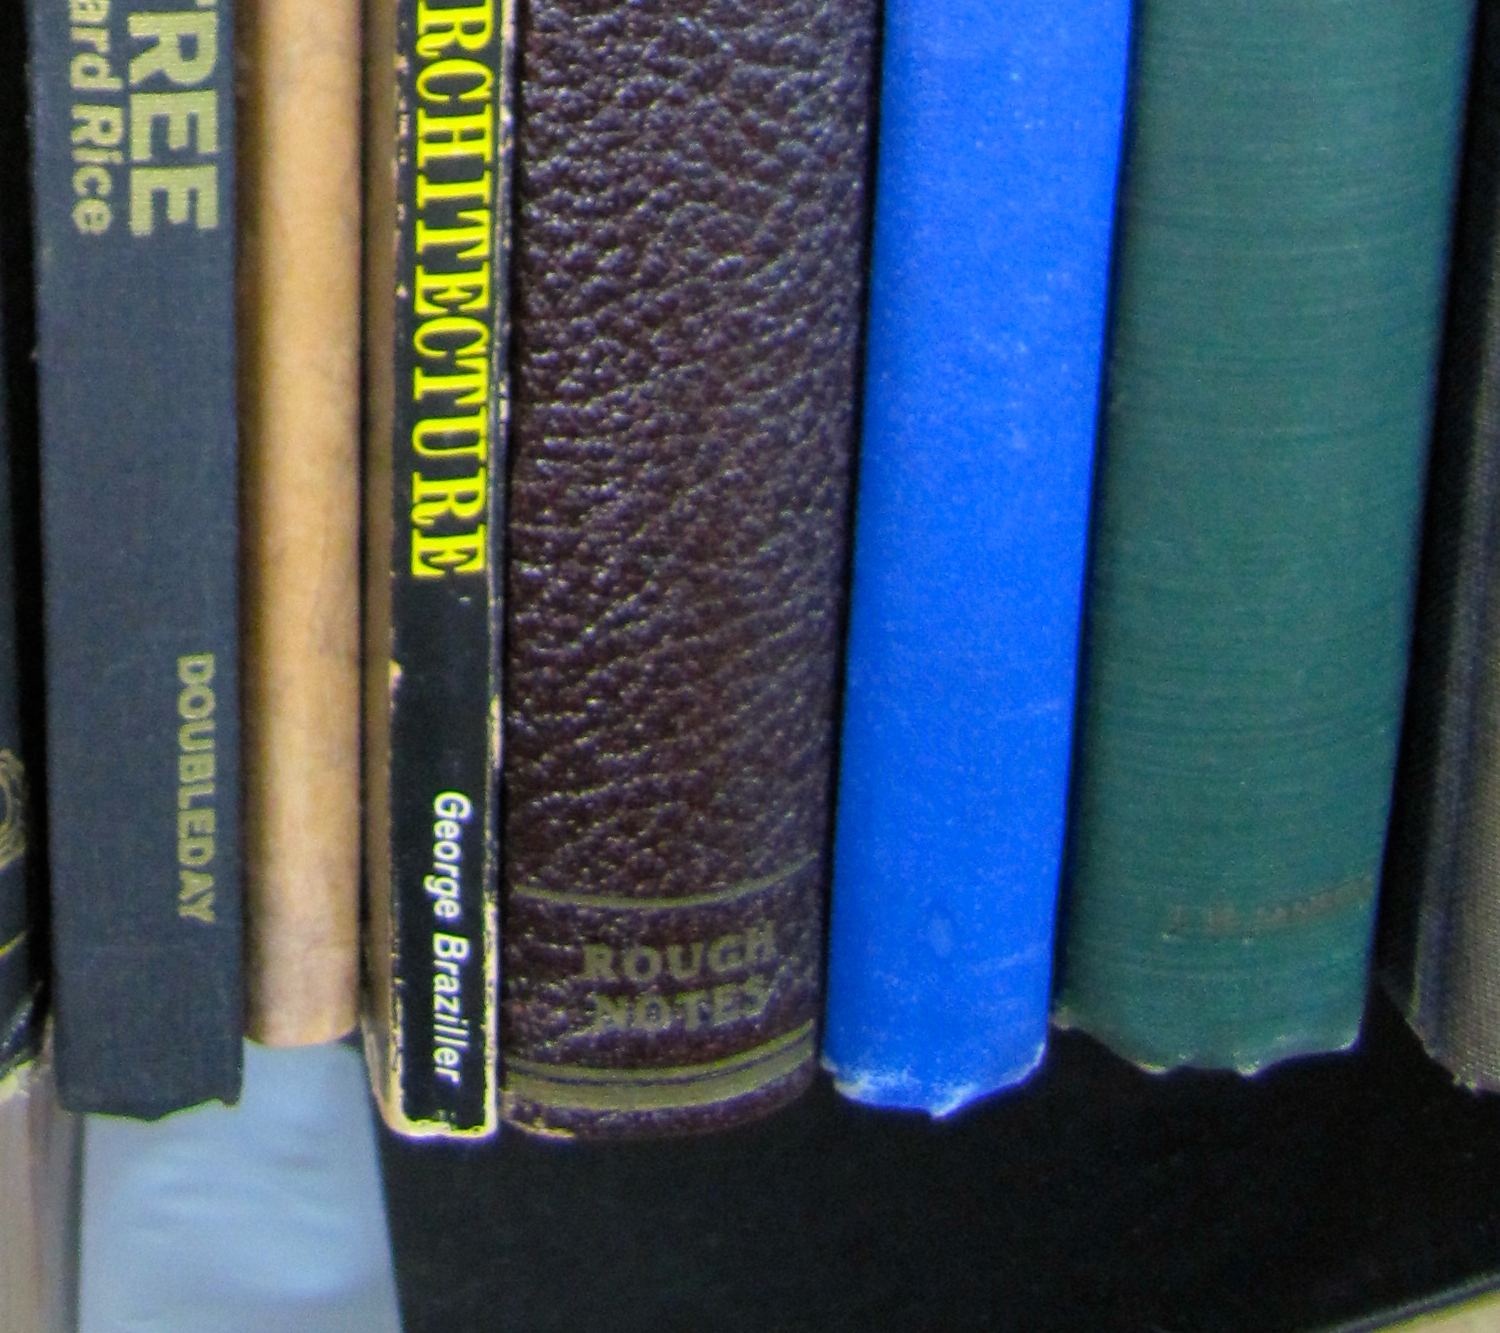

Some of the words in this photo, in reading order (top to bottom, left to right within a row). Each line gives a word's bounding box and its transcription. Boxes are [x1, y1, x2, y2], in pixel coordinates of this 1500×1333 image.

[70, 103, 124, 236] Rice
[176, 651, 217, 924] DOUBLEDAY
[423, 789, 473, 920] George
[432, 932, 472, 1087] Braziller
